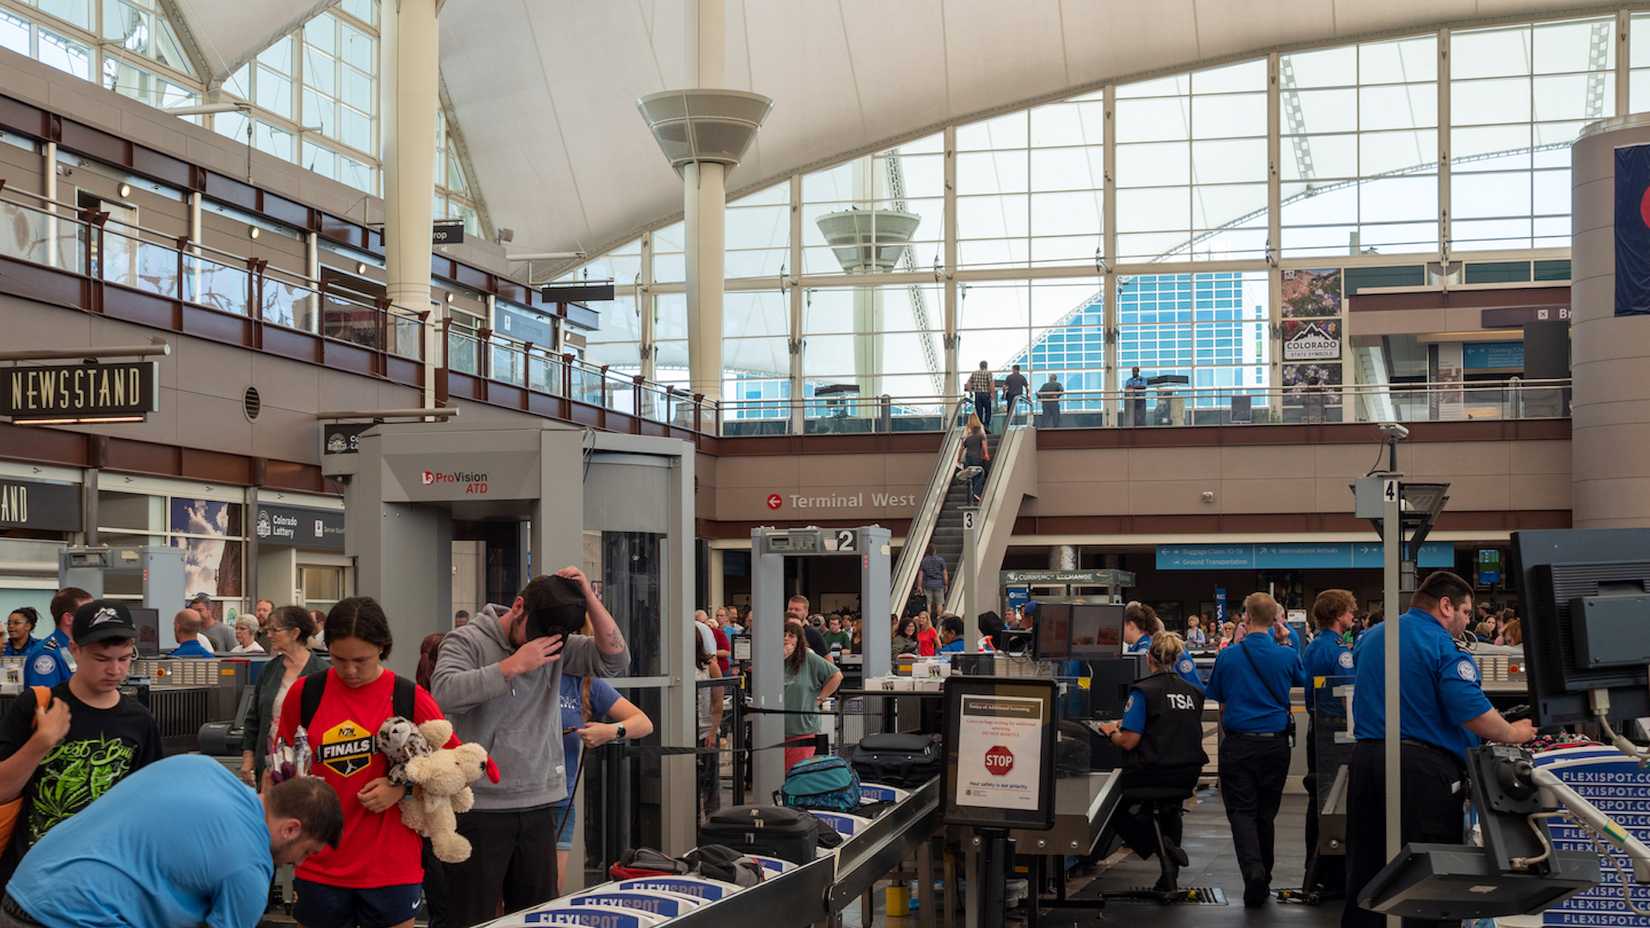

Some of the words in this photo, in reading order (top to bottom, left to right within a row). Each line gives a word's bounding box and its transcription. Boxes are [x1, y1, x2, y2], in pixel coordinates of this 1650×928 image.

[433, 232, 448, 240] rop
[1286, 341, 1337, 350] COLORADO
[12, 368, 140, 409] NEWSSTAND
[435, 471, 488, 483] ProVision
[465, 483, 488, 494] ATD
[1386, 481, 1395, 500] 4
[789, 492, 863, 508] Terminal
[871, 493, 916, 506] West
[273, 514, 297, 526] Colorado
[966, 512, 973, 528] 3
[273, 525, 295, 539] Lottery
[838, 530, 854, 551] 2
[1166, 693, 1196, 710] TSA
[323, 739, 370, 758] FINALS
[986, 754, 1013, 767] STOP
